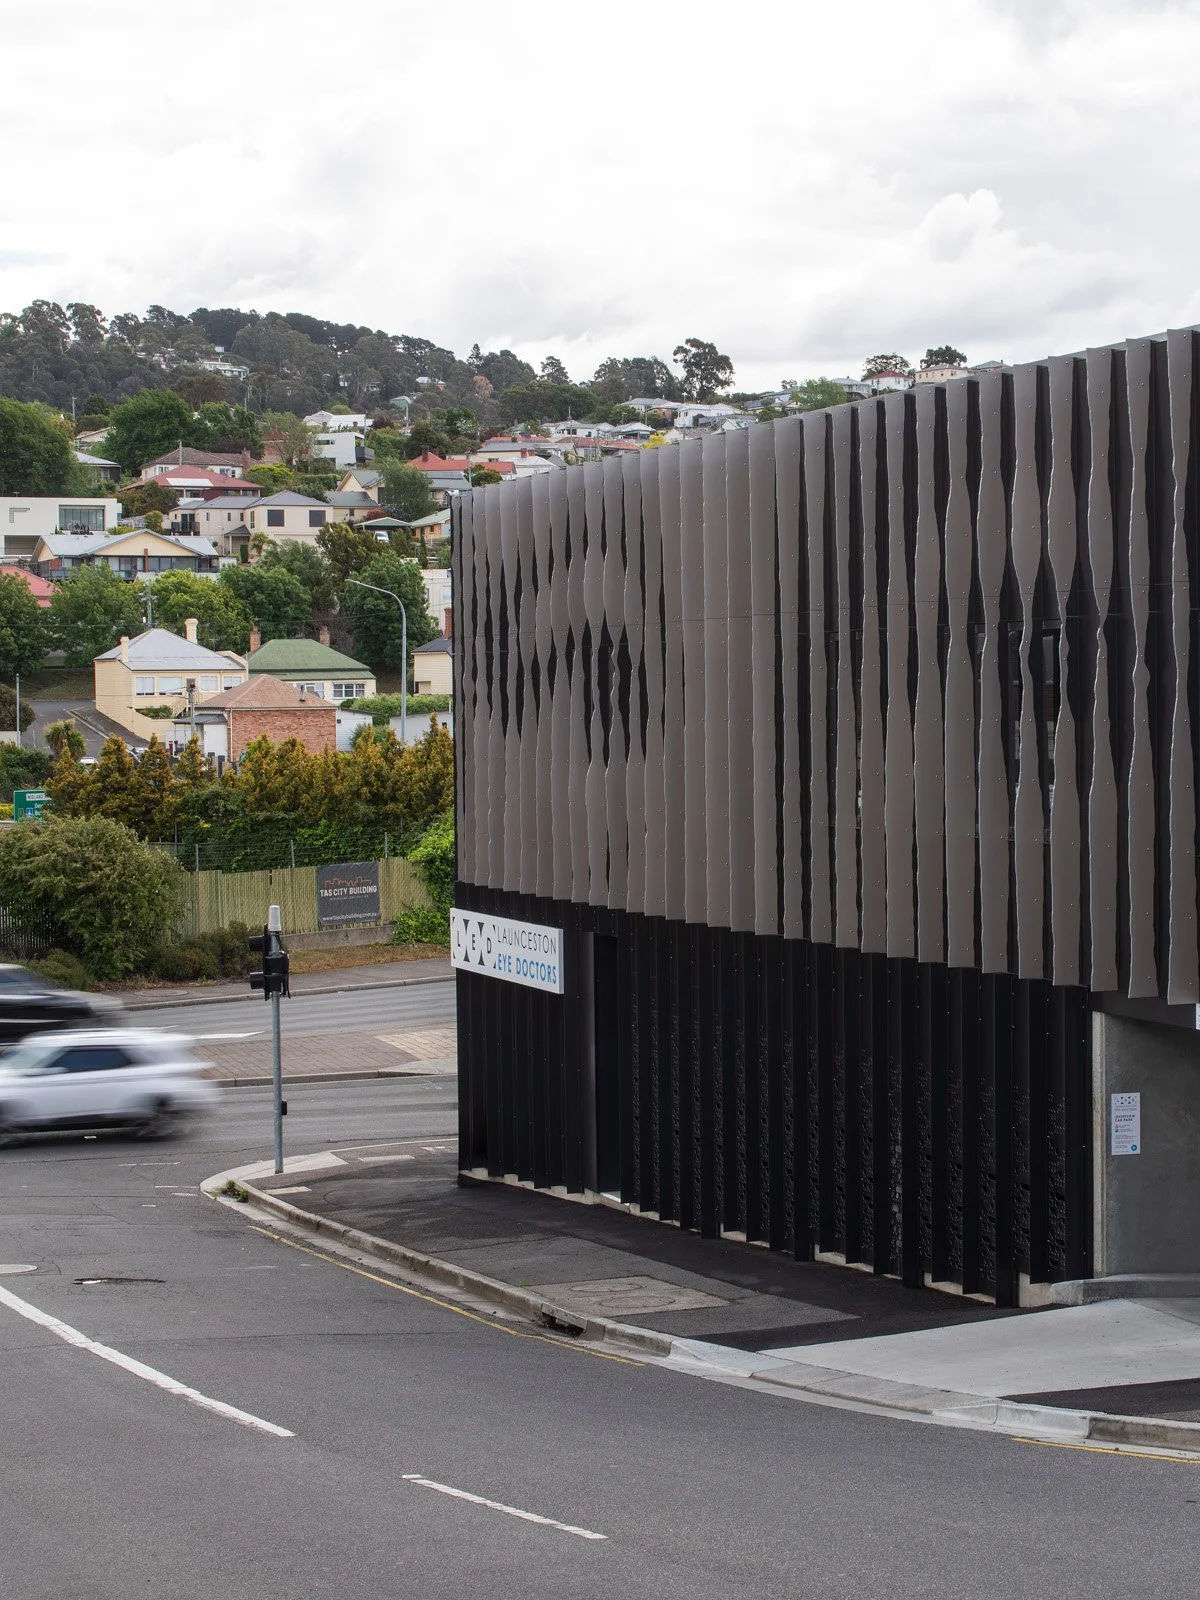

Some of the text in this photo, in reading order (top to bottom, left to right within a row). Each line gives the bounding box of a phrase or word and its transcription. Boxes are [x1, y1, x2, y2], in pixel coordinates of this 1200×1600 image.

[333, 888, 347, 896] CITY
[349, 885, 377, 894] BUILDING
[497, 925, 557, 955] LAUNCESTON
[497, 953, 557, 984] EYE DOCTORS
